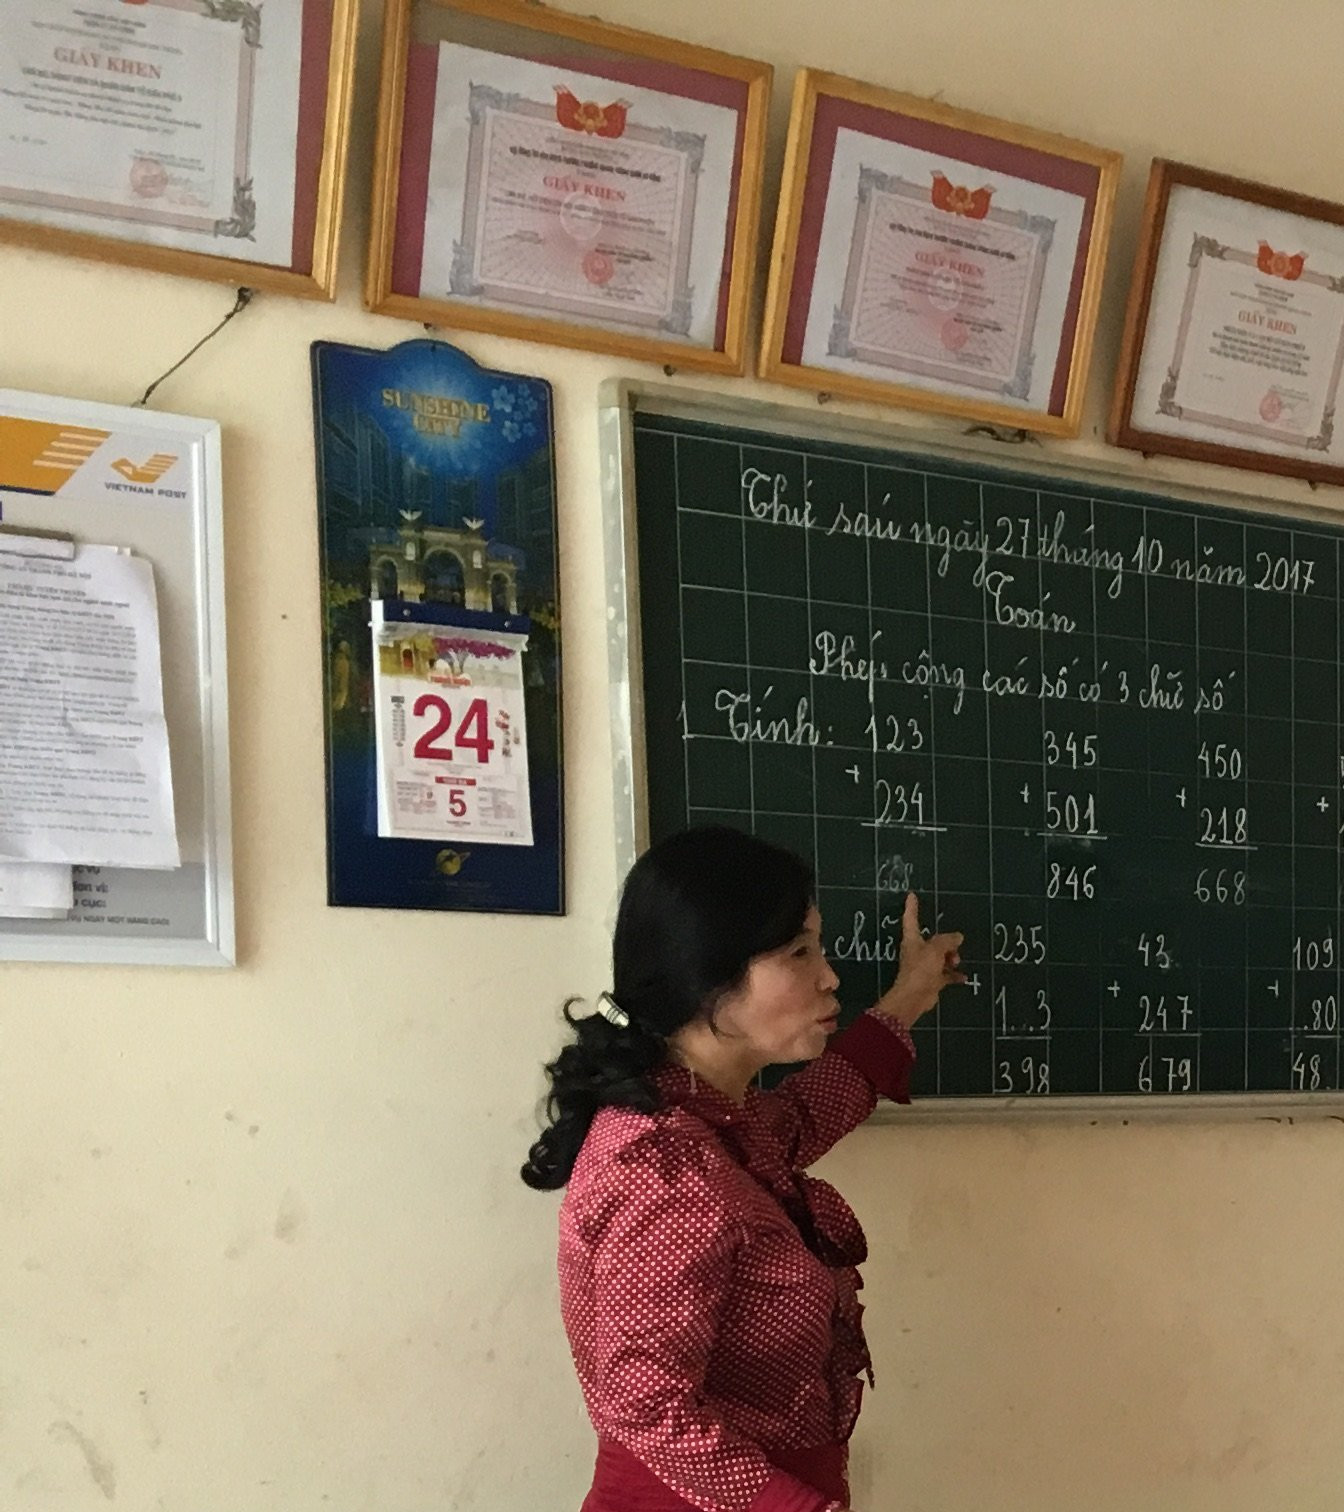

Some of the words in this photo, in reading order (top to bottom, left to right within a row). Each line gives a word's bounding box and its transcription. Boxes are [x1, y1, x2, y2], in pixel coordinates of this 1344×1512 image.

[107, 55, 162, 80] KHEN
[104, 481, 154, 495] VIETNAM
[157, 488, 187, 500] POST
[741, 467, 817, 529] Thứ
[827, 492, 902, 540] sáu
[910, 519, 990, 588] ngày
[995, 516, 1030, 559] 27
[1037, 509, 1124, 600] tháng
[1131, 535, 1164, 575] 10
[1170, 545, 1246, 587] năm
[1253, 551, 1316, 595] 2017
[984, 569, 1077, 634] Toán
[809, 629, 889, 704] Phép
[902, 648, 966, 716] cộng
[983, 655, 1030, 697] các
[1037, 656, 1080, 700] số
[1079, 659, 1109, 703] có
[1117, 669, 1131, 704] 3
[1138, 662, 1186, 711] chữ
[1193, 669, 1237, 715] số
[412, 693, 495, 764] 24
[715, 684, 834, 747] Tính:
[863, 713, 925, 753] 123
[1043, 729, 1098, 771] 345
[1197, 741, 1243, 780] 450
[448, 788, 468, 818] 5
[874, 778, 925, 825] 234
[1045, 790, 1099, 835] 501
[1199, 806, 1248, 846] 218
[1046, 861, 1097, 900] 846
[1194, 867, 1247, 906] 668
[834, 909, 900, 963] chữ
[993, 921, 1047, 966] 235
[1292, 935, 1334, 971] 109
[1138, 995, 1194, 1033] 247
[993, 1055, 1051, 1095] 398
[1138, 1055, 1193, 1094] 679
